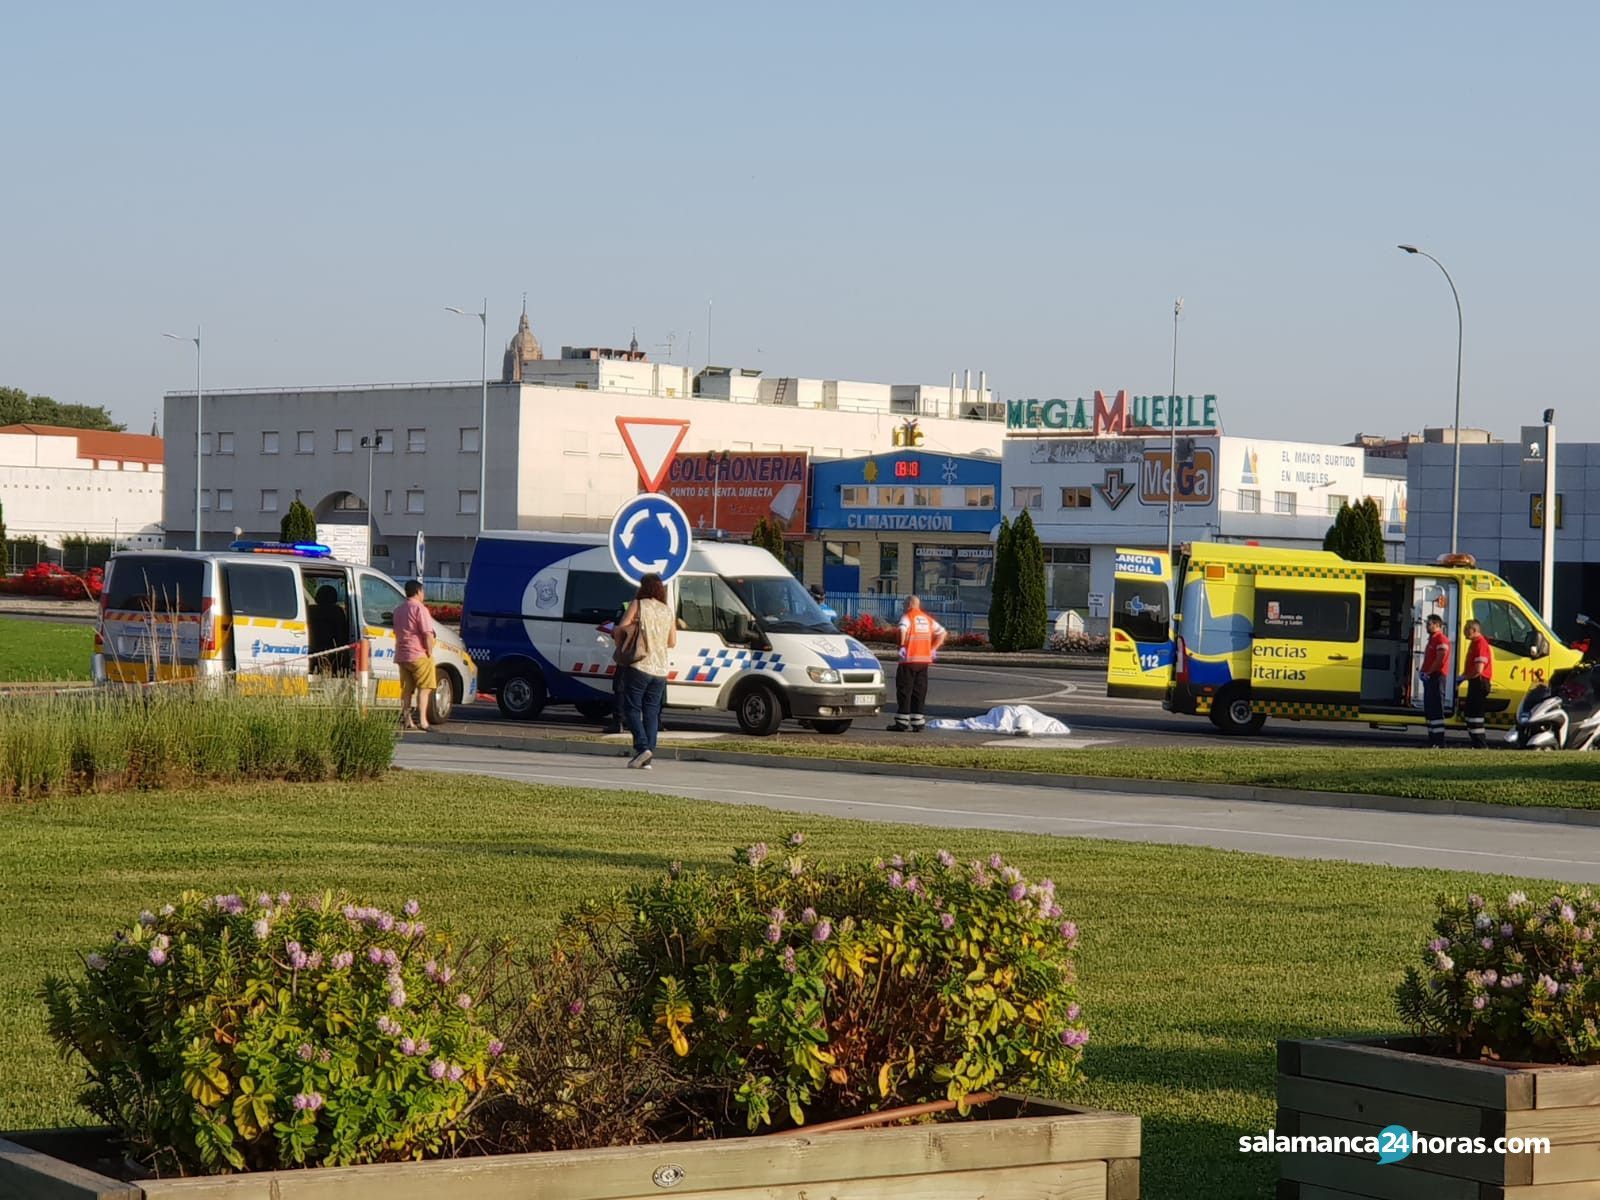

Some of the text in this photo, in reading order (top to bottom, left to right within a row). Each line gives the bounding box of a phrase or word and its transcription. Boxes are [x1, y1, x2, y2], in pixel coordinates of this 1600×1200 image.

[1007, 397, 1086, 429] MEGA
[1282, 451, 1356, 467] EL MAYOR SURTIDO
[669, 456, 803, 482] COLCHONERIA
[1281, 470, 1329, 484] EN MUEBLES
[670, 487, 773, 497] PUNTO DE VENTA DIRECTA
[848, 511, 952, 530] CLIMATIZACIÓN
[1252, 643, 1308, 658] encias
[1140, 654, 1159, 668] 112
[1253, 664, 1306, 680] itarias
